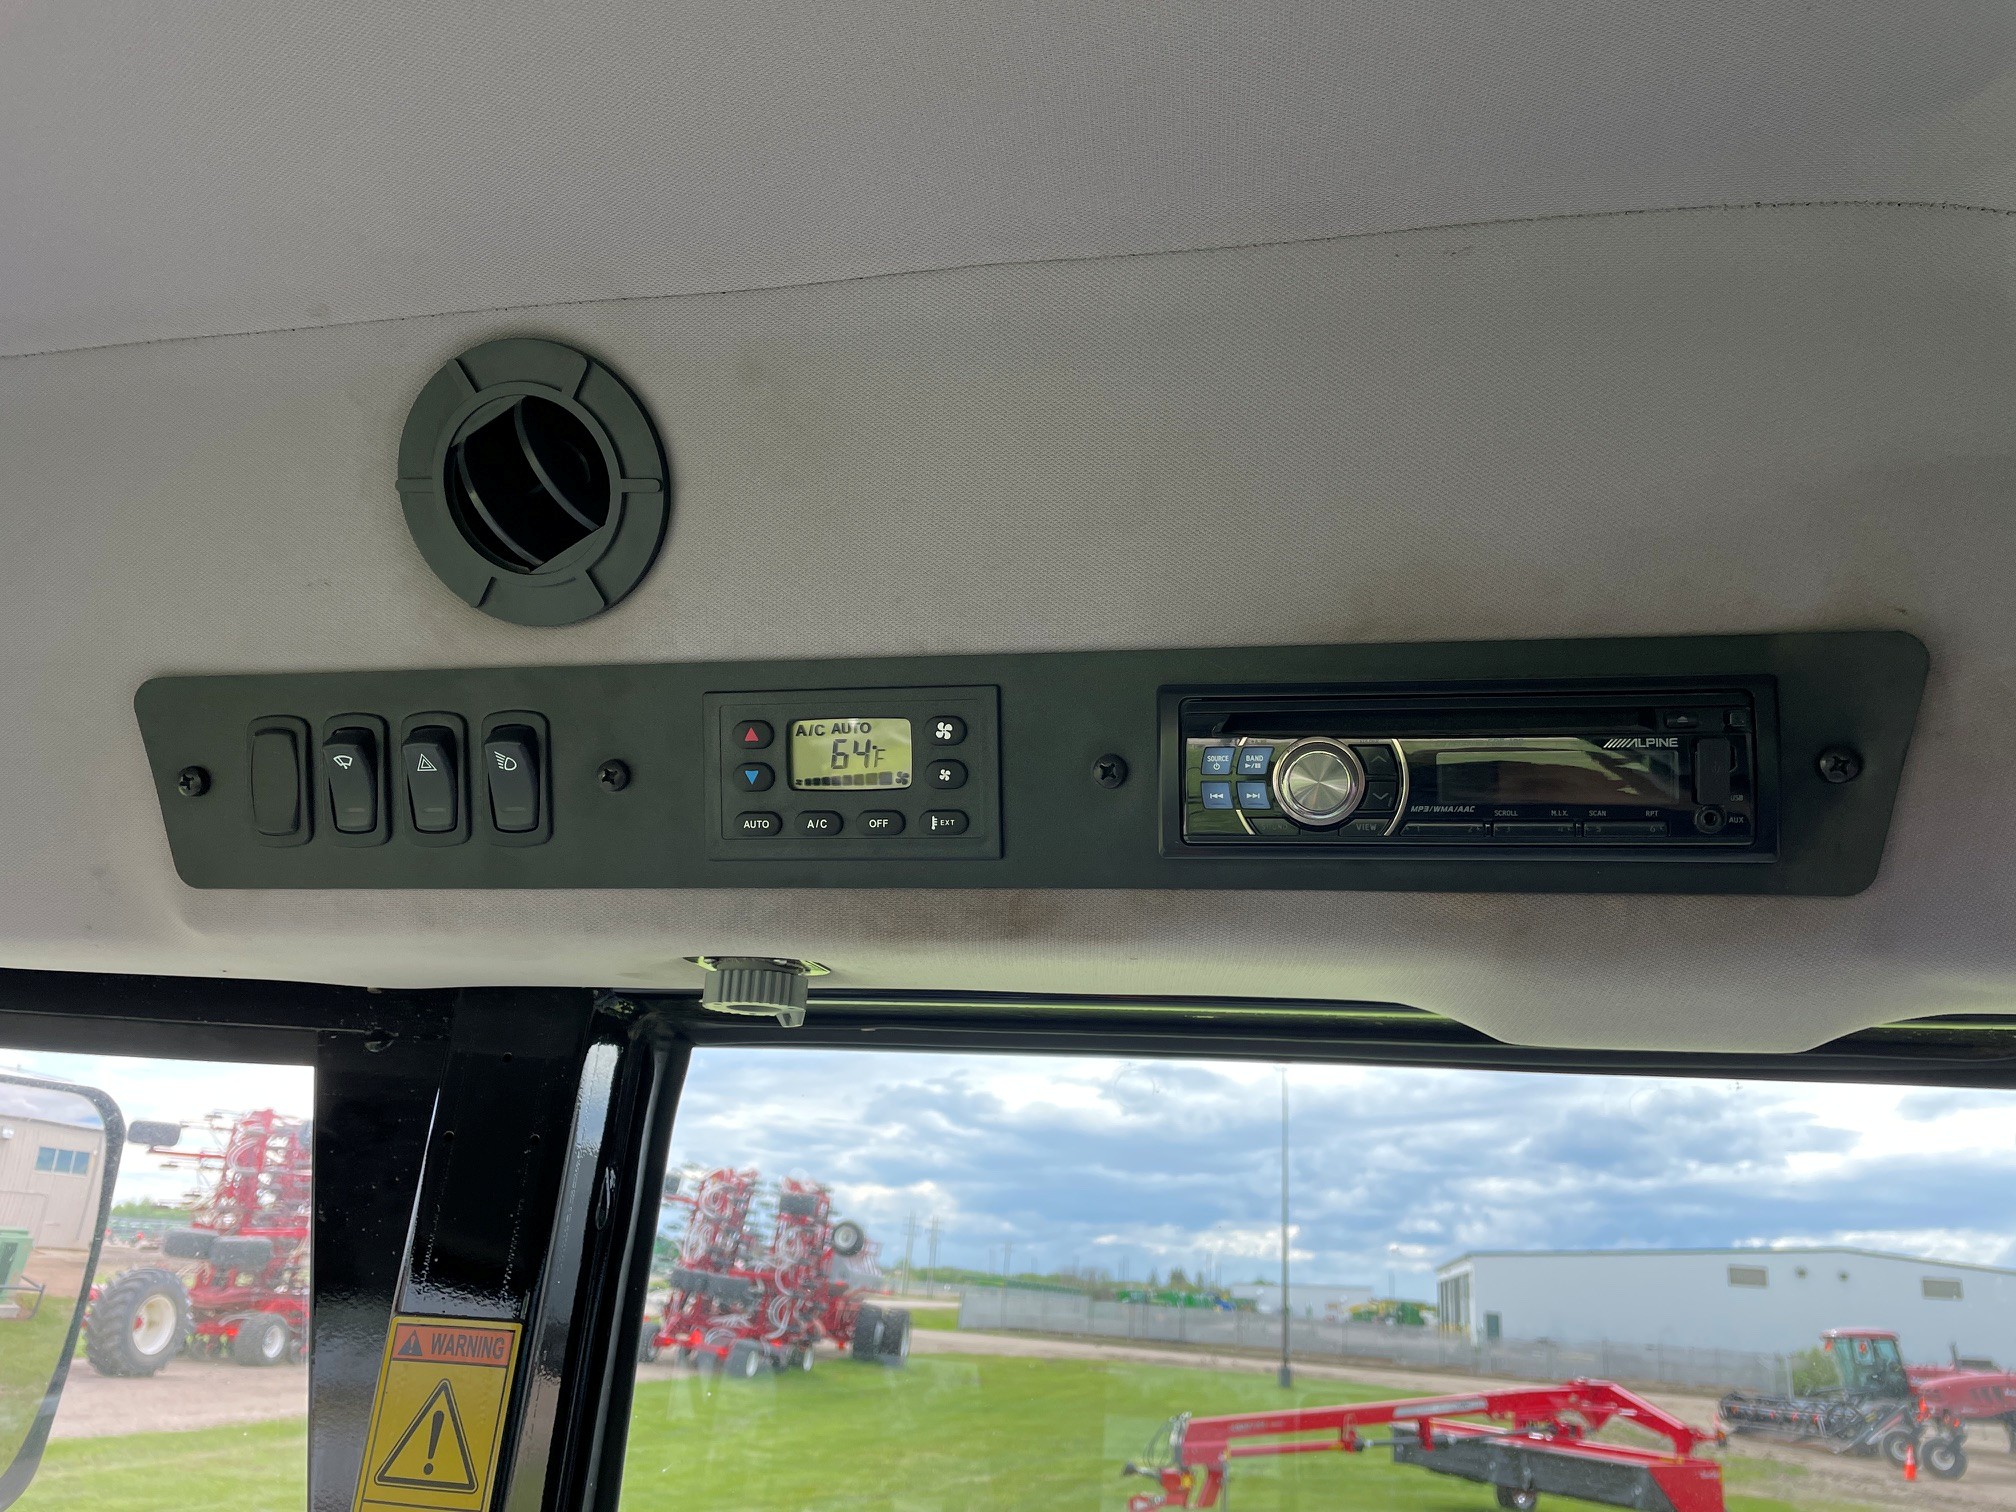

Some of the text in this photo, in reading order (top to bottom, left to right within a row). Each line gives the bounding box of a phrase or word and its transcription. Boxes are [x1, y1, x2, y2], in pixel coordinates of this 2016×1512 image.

[795, 722, 872, 737] A/C AUTO
[1626, 737, 1679, 748] ALPINE
[1410, 805, 1476, 813] MP3/WMA/AAC
[1494, 809, 1518, 817] SCROLL
[1588, 809, 1607, 817] SCAN
[743, 819, 770, 829] AUTO
[806, 819, 828, 829] A/C
[868, 819, 889, 828] OFF
[1728, 816, 1744, 824] AUX
[1356, 823, 1377, 831] VIEW
[430, 1332, 505, 1360] WARNING
